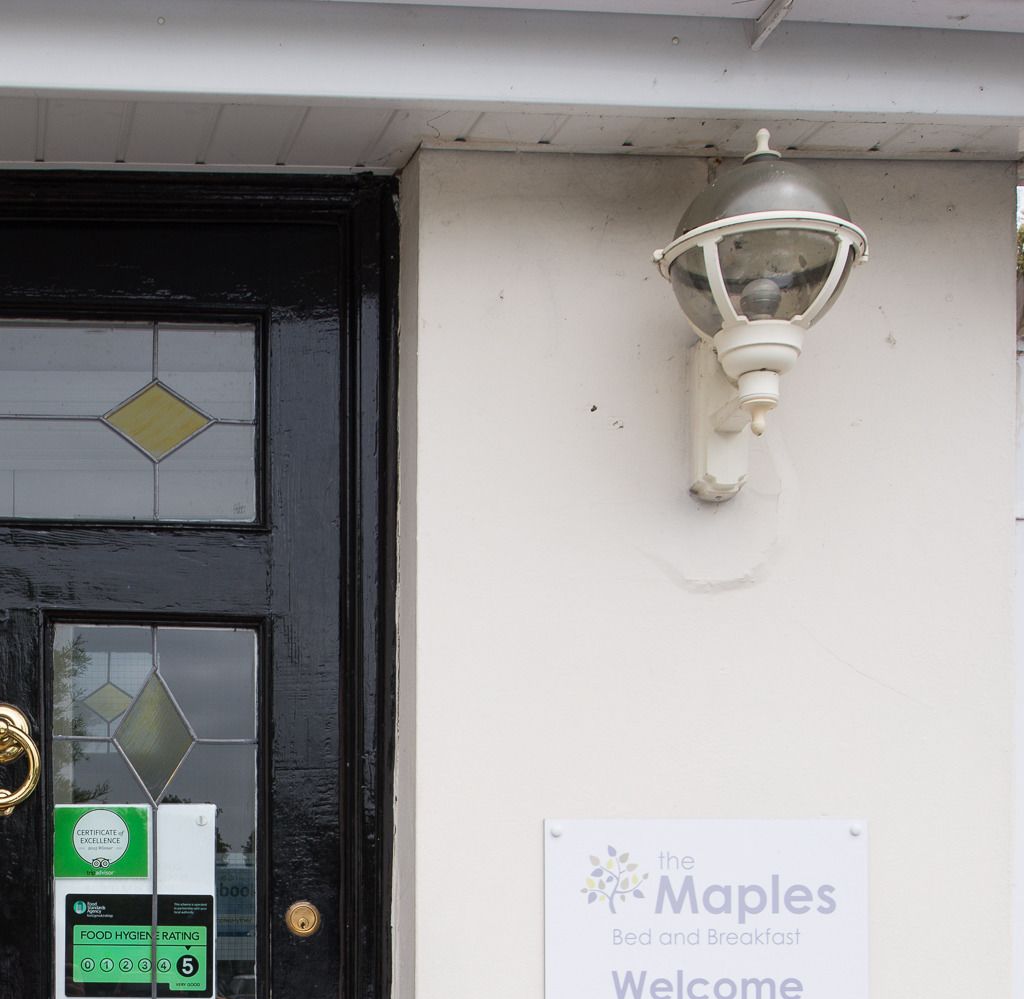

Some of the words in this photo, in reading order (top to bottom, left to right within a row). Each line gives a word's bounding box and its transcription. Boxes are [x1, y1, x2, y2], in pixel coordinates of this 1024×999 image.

[658, 851, 695, 870] the
[654, 874, 837, 924] Maples
[80, 930, 113, 940] FOOD
[116, 931, 160, 940] HYGIENE
[162, 931, 200, 941] RATING
[612, 928, 651, 946] Bed
[659, 928, 700, 946] and
[708, 928, 801, 946] Breakfast
[182, 958, 193, 975] 5
